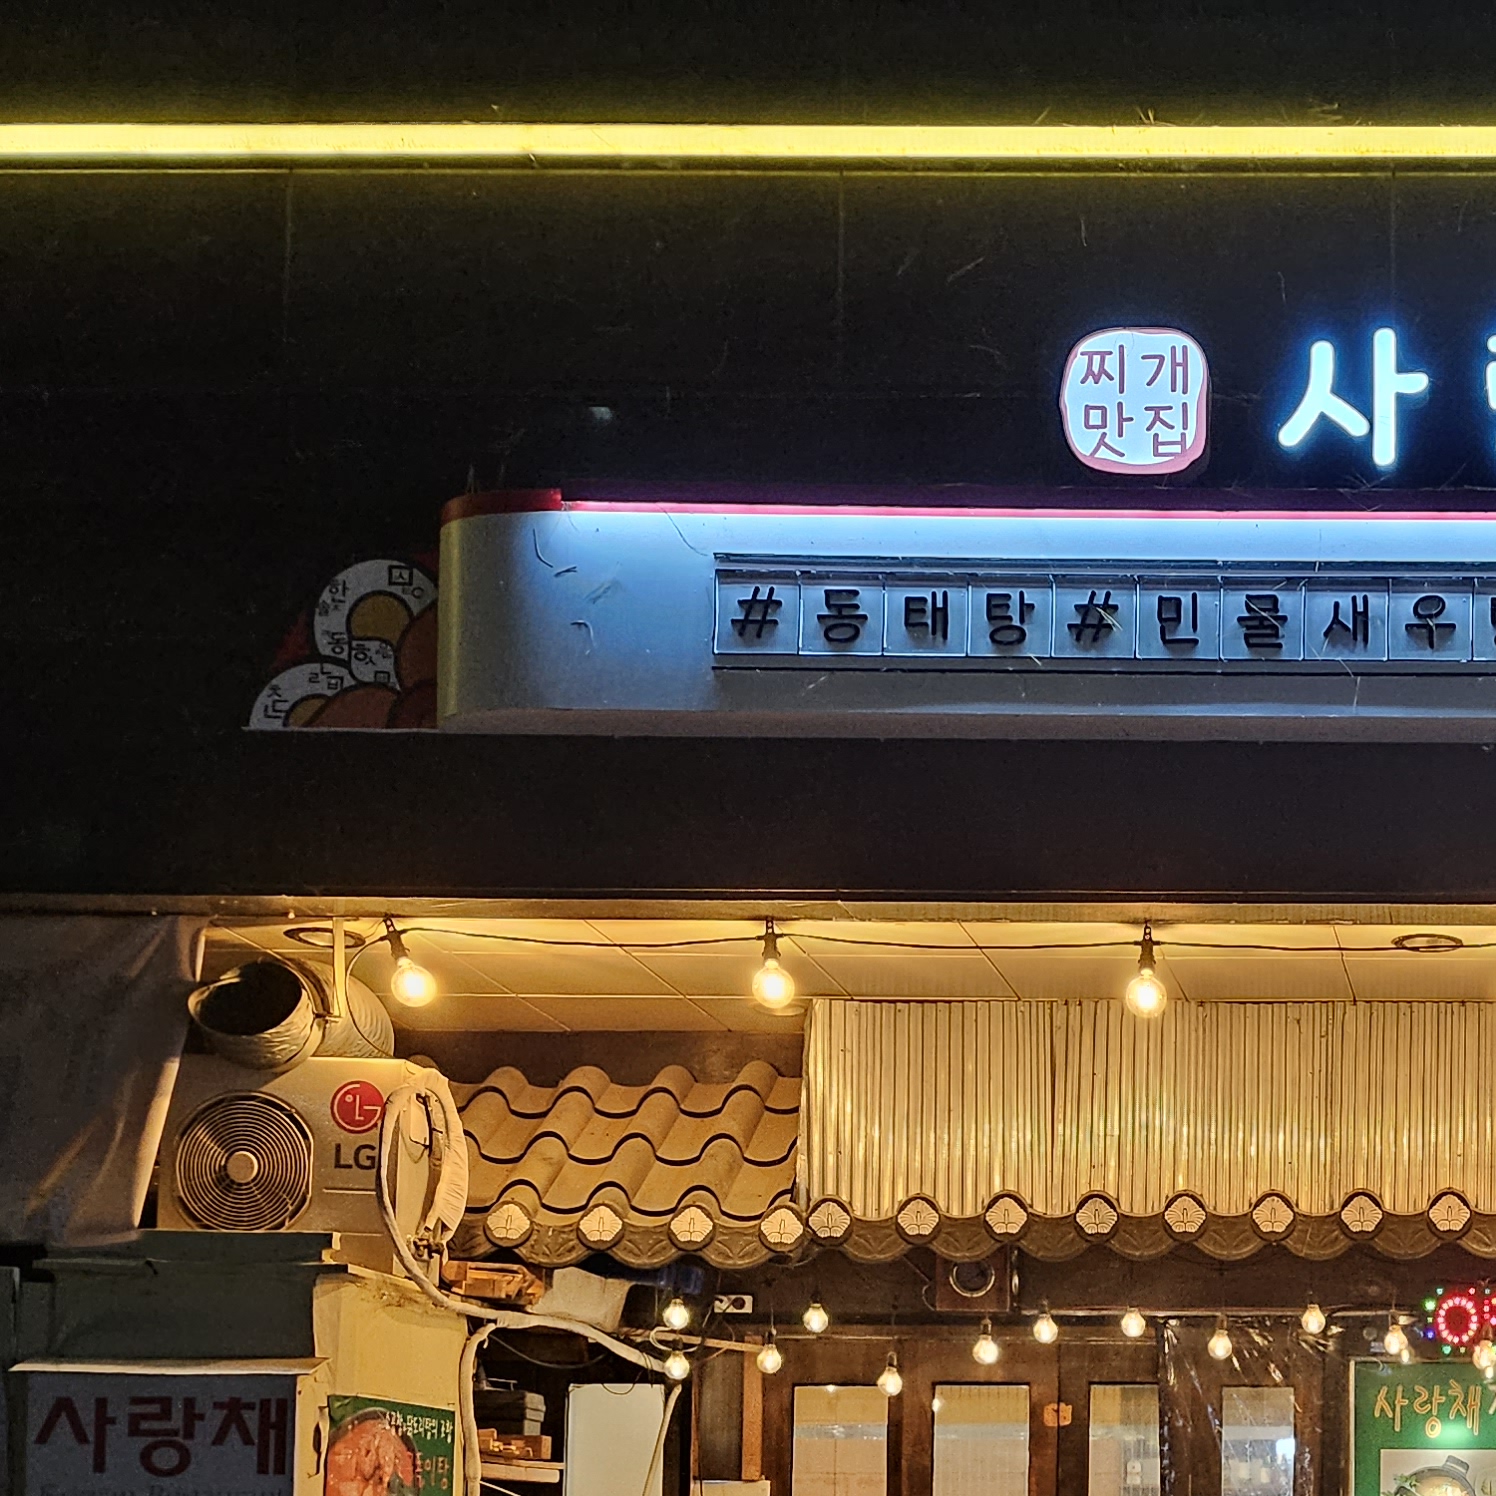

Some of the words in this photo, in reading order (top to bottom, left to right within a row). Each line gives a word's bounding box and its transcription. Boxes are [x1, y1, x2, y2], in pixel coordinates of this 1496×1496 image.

[1078, 343, 1191, 396] 찌개
[1080, 402, 1191, 459] 맛집
[334, 1143, 377, 1170] LG
[33, 1395, 289, 1477] 사랑채
